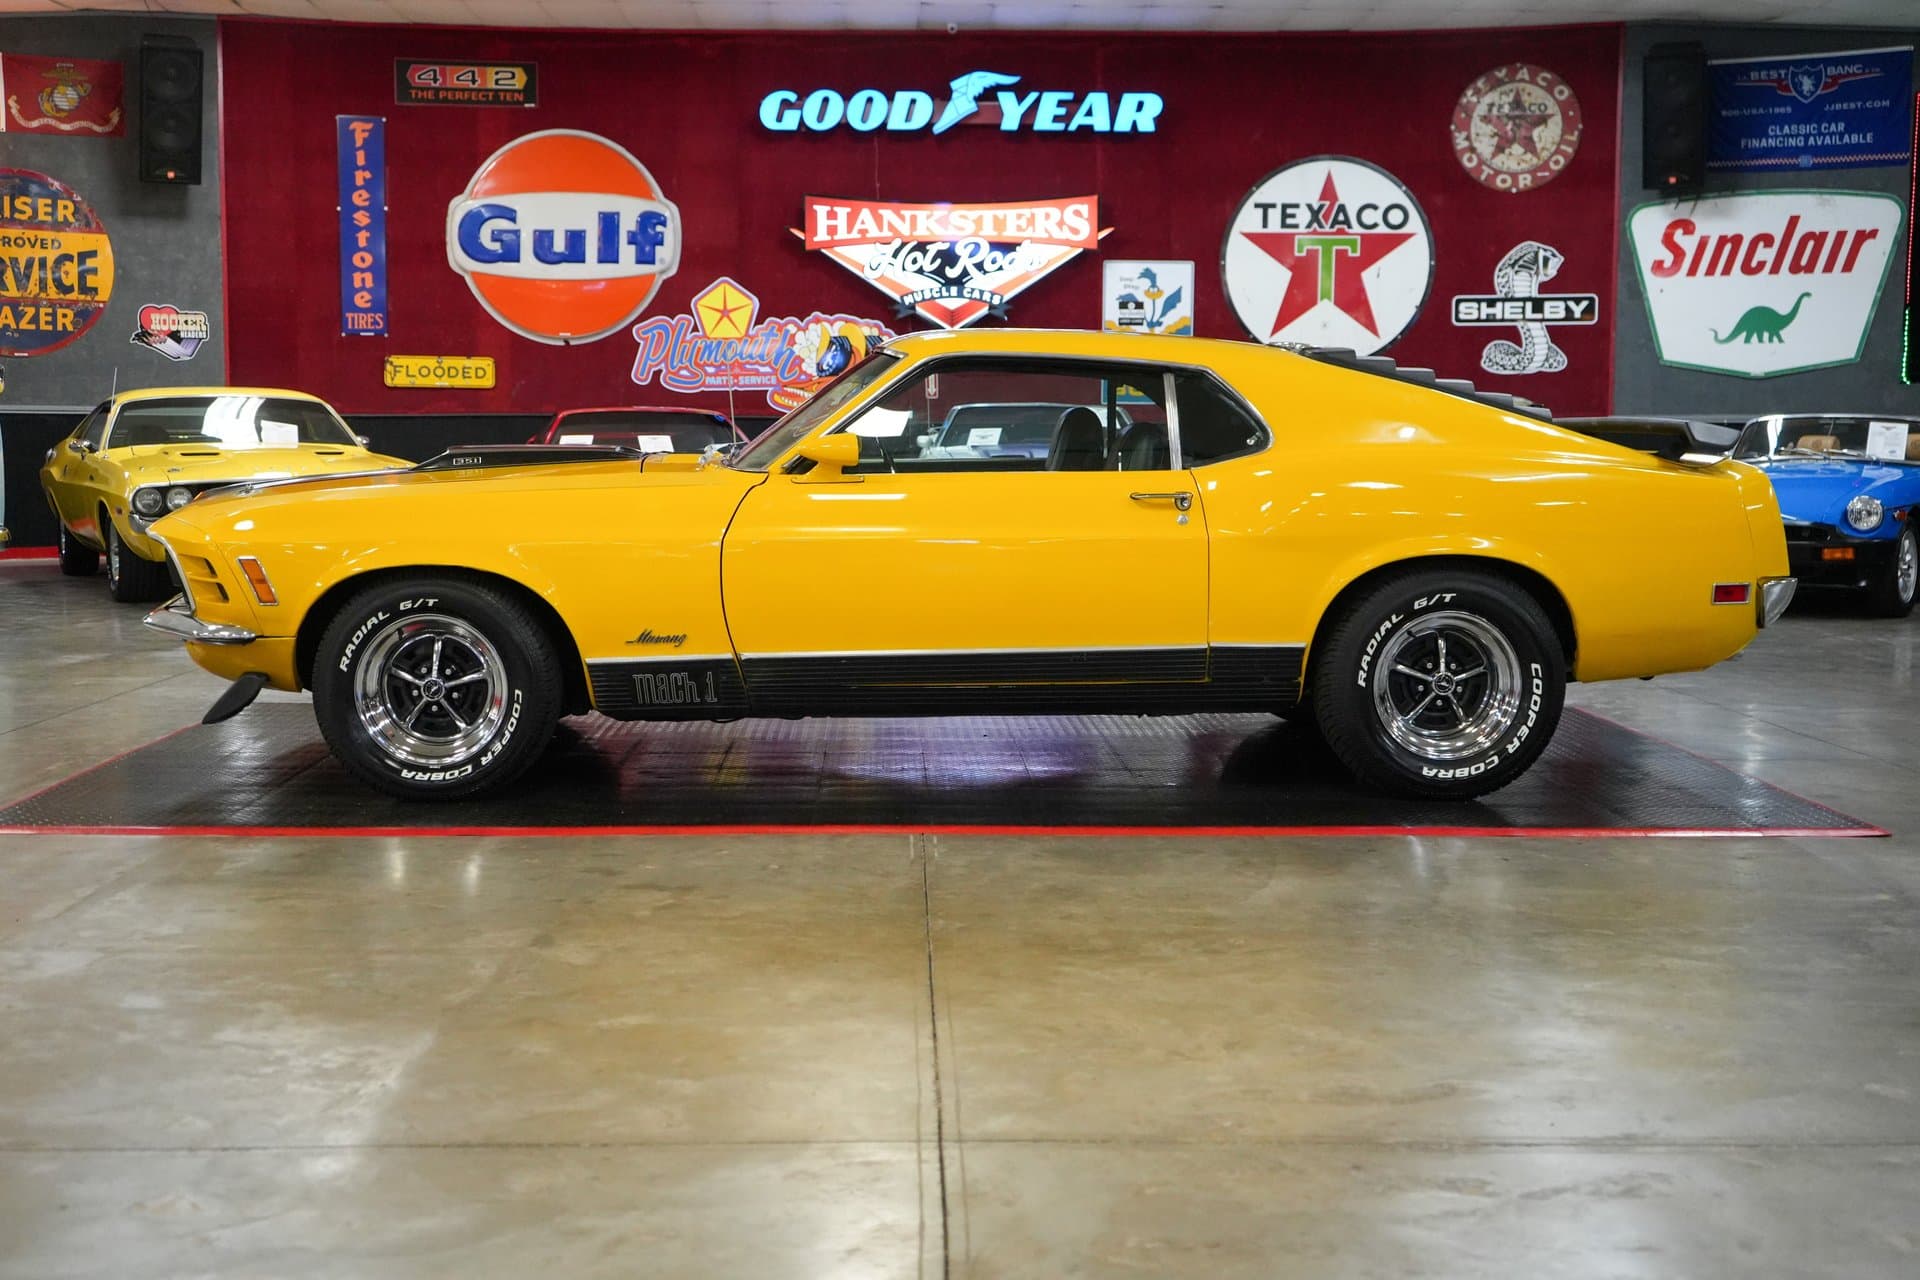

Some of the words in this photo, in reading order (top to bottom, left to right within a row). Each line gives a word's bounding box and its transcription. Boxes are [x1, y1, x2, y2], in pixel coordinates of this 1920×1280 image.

[1750, 70, 1787, 80] BEST
[1827, 64, 1863, 76] BANC
[409, 90, 435, 99] THE
[439, 90, 494, 100] PERFECT
[498, 92, 524, 101] TEN
[759, 89, 933, 132] GOOD
[998, 91, 1164, 132] YEAR
[1741, 137, 1805, 149] FINANCING
[1807, 133, 1873, 146] AVAILABLE
[1768, 123, 1818, 136] CLASSIC
[1821, 122, 1845, 133] CAR
[0, 195, 76, 223] ISER
[349, 121, 375, 309] Firestone
[812, 203, 1091, 242] HANKSTERS
[1254, 202, 1410, 231] TEXACO
[0, 235, 62, 249] ROVED
[458, 203, 668, 265] Gulf
[1650, 215, 1879, 279] Sinclair
[863, 238, 950, 280] Hot
[903, 286, 958, 306] MUSCLE
[963, 286, 1002, 305] CARS
[1458, 300, 1590, 320] SHELBY
[150, 313, 207, 331] HOOKER
[345, 313, 384, 329] TIRES
[640, 320, 799, 386] Plymouth
[393, 365, 487, 380] FLOODED
[738, 376, 777, 385] SERVICE
[339, 610, 391, 672] RADIAL
[399, 598, 439, 611] G/T
[1357, 613, 1404, 688] RADIAL
[1413, 593, 1457, 610] G/T
[704, 671, 718, 703] 1
[1505, 662, 1543, 754] COOPER
[480, 688, 523, 766] COOPER
[401, 764, 473, 781] COBRA
[1422, 753, 1500, 779] COBRA
